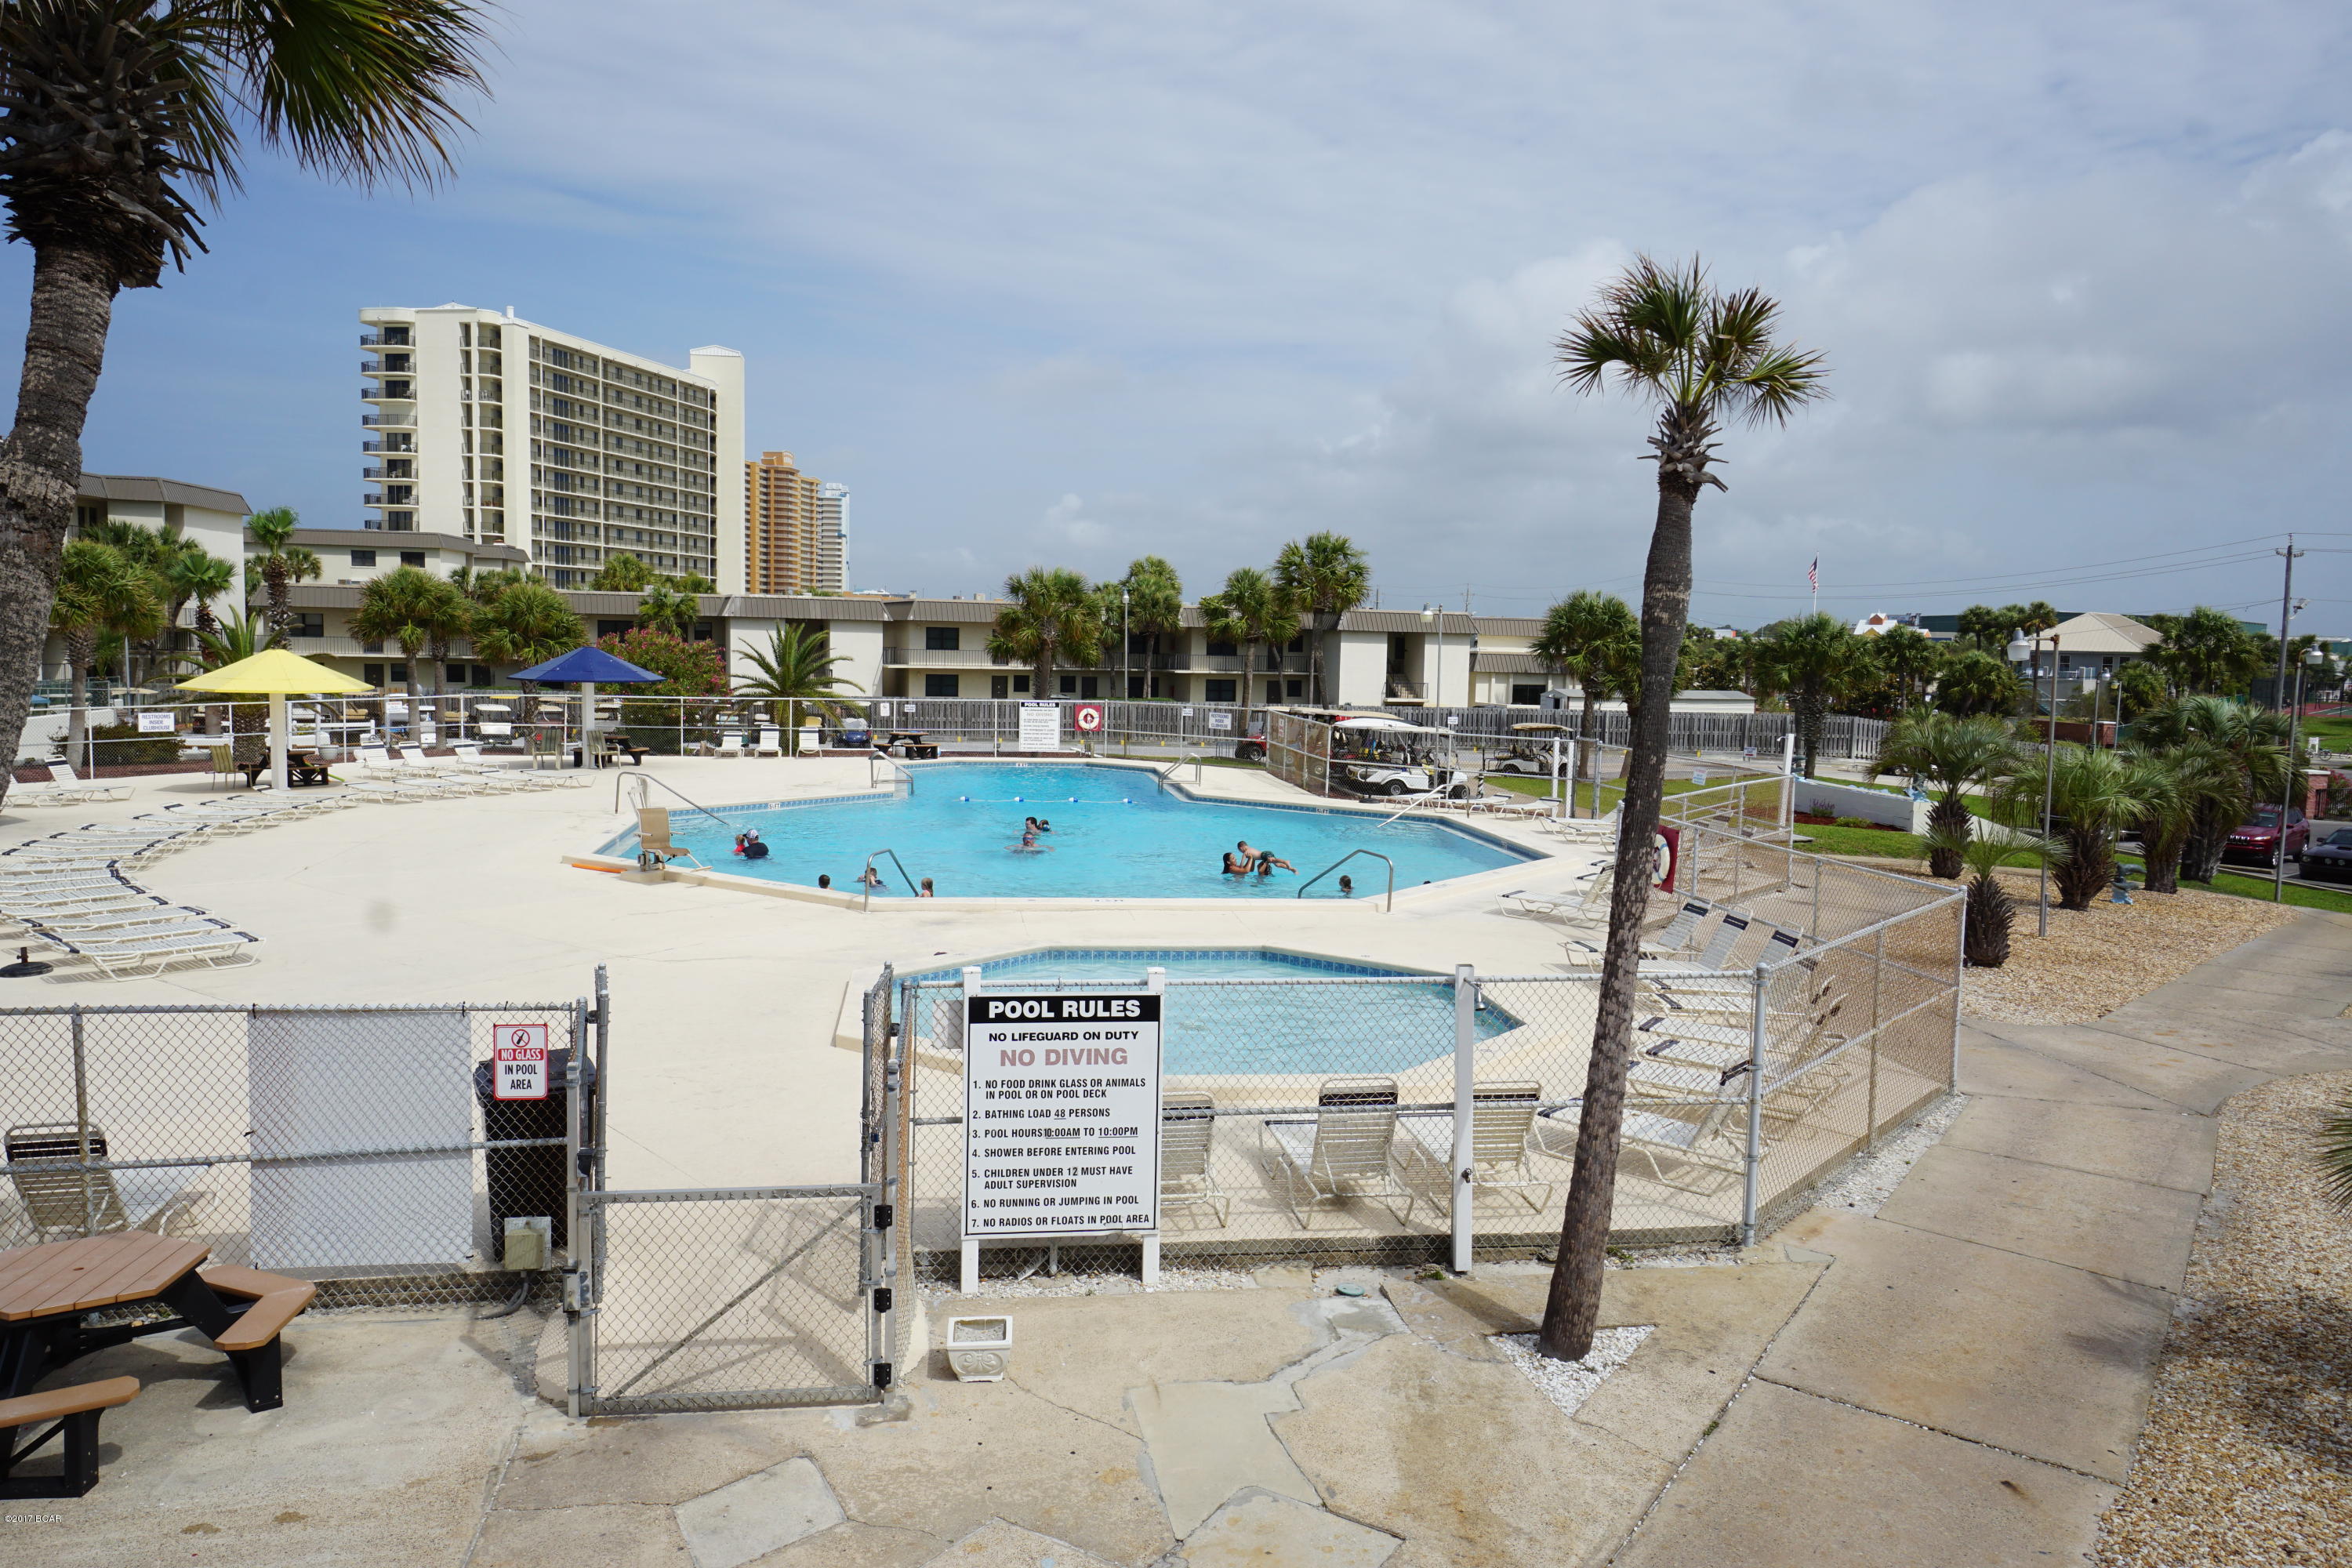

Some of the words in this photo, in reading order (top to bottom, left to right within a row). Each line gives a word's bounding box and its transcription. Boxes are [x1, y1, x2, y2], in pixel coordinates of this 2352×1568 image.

[989, 1001, 1054, 1018] POOL
[1063, 1000, 1140, 1017] RULES
[1012, 1032, 1078, 1041] LIFEGUARD
[1083, 1032, 1100, 1040] ON
[1105, 1031, 1138, 1040] DUTY
[501, 1049, 514, 1060] NO
[515, 1049, 541, 1060] GLASS
[1000, 1049, 1035, 1066] NO
[1045, 1047, 1127, 1065] DIVING
[504, 1064, 514, 1075] IN
[516, 1064, 538, 1075] POOL
[510, 1079, 532, 1090] AREA
[1001, 1080, 1025, 1088] FOOD
[1029, 1080, 1056, 1088] DRINK
[1060, 1079, 1087, 1087] GLASS
[1091, 1079, 1102, 1087] OR
[1105, 1078, 1145, 1087] ANIMALS
[999, 1091, 1022, 1099] POOL
[1041, 1090, 1052, 1098] ON
[1057, 1090, 1080, 1098] POOL
[1083, 1089, 1106, 1098] DECK
[973, 1110, 981, 1119] 2.
[985, 1109, 1024, 1119] BATHING
[1029, 1109, 1051, 1118] LOAD
[1069, 1109, 1109, 1117] PERSONS
[973, 1130, 980, 1138] 3.
[985, 1129, 1008, 1138] POOL
[1012, 1129, 1042, 1138] HOURS
[1083, 1127, 1094, 1136] TO
[985, 1149, 1023, 1157] SHOWER
[1027, 1148, 1062, 1156] BEFORE
[1065, 1146, 1109, 1156] ENTERING
[985, 1169, 1029, 1178] CHILDREN
[1033, 1168, 1063, 1177] UNDER
[1067, 1167, 1077, 1176] 12
[1081, 1167, 1106, 1175] MUST
[985, 1181, 1013, 1189] ADULT
[1017, 1179, 1076, 1189] SUPERVISION
[1000, 1198, 1040, 1207] RUNNING
[1059, 1196, 1100, 1206] JUMPING
[1116, 1196, 1138, 1204] POOL
[984, 1218, 996, 1227] NO
[1000, 1218, 1032, 1226] RADIOS
[1036, 1217, 1047, 1225] OR
[1051, 1216, 1083, 1225] FLOATS
[1100, 1215, 1123, 1224] POOL
